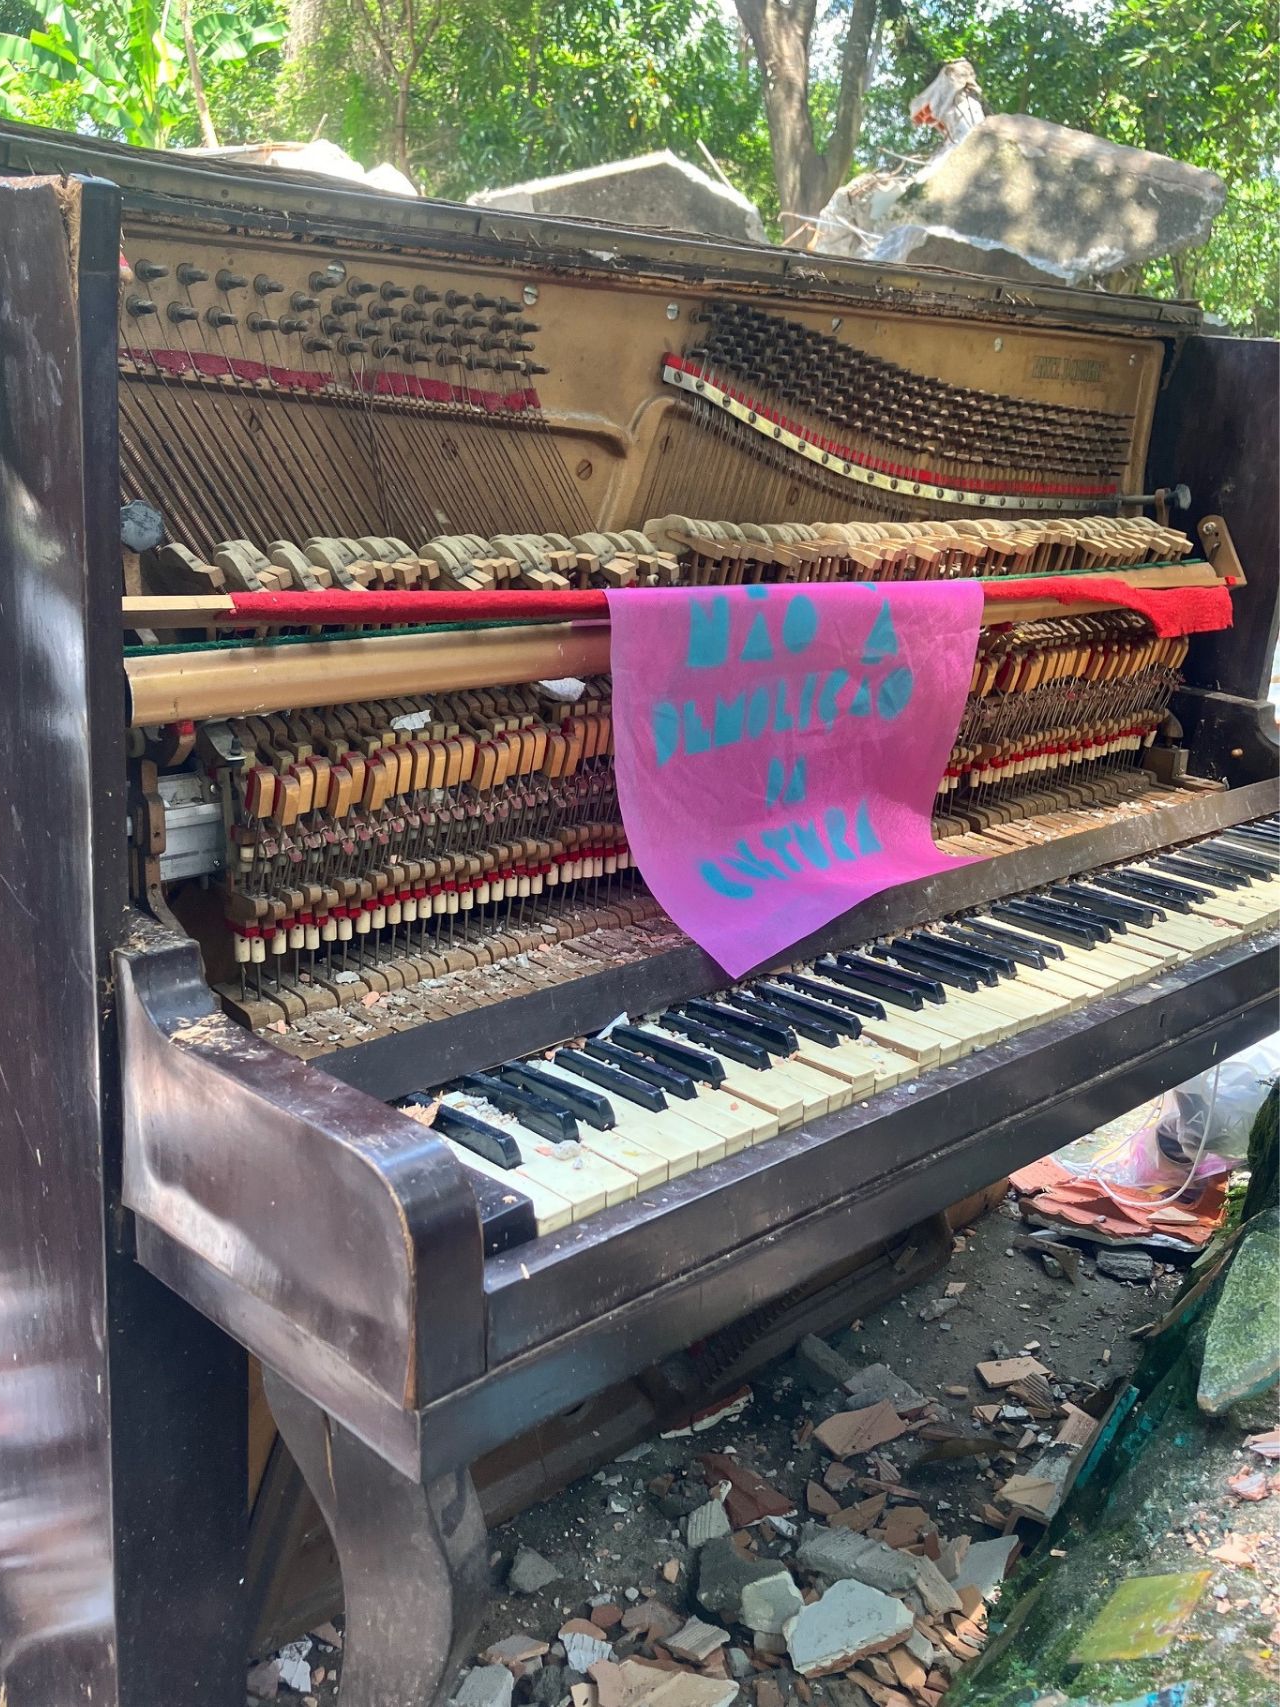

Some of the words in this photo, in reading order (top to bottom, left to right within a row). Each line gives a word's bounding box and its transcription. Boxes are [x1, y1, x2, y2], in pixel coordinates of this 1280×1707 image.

[686, 585, 818, 669] NÃO
[651, 654, 915, 769] DEMOLIÇÃO
[765, 756, 807, 808] DA
[698, 796, 883, 900] CULTURA
